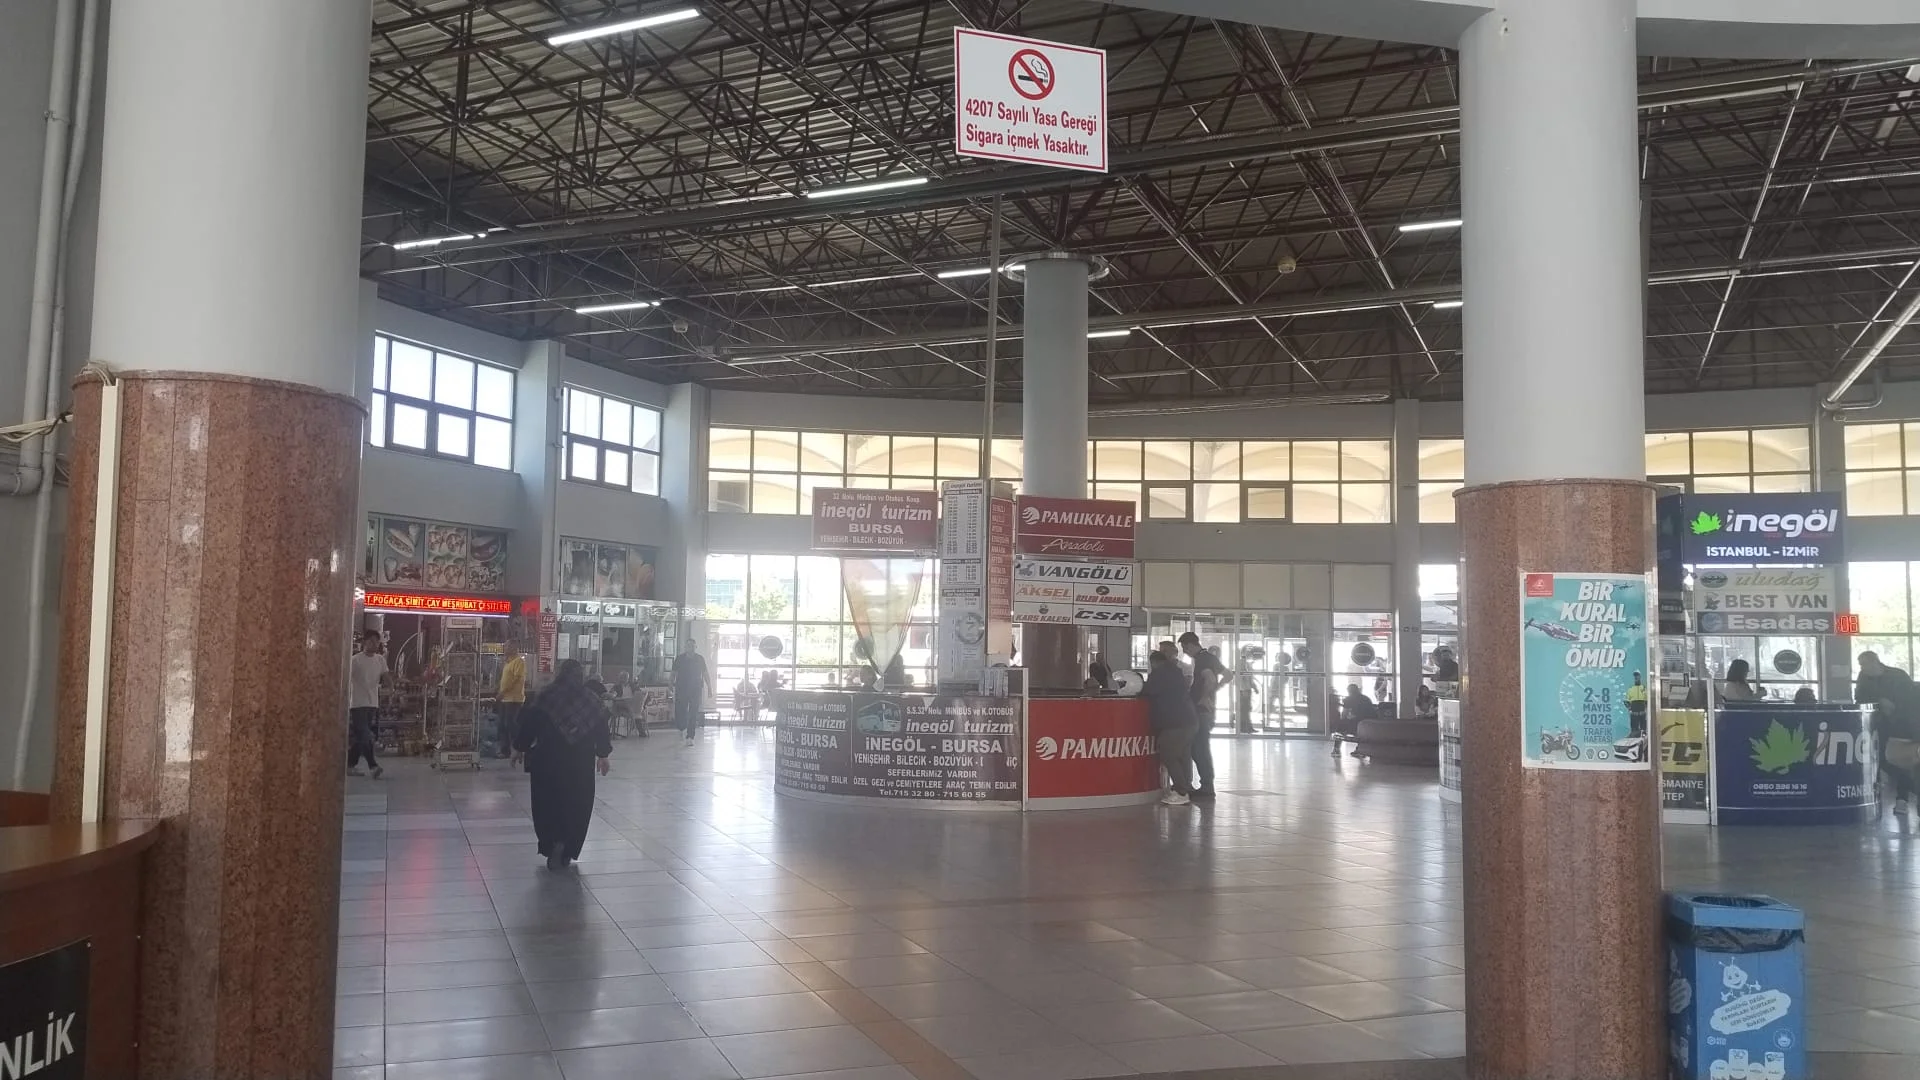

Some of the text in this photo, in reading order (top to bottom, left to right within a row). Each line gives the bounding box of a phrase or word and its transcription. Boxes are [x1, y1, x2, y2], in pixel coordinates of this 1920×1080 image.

[966, 98, 1097, 136] 4207 Sayılı Yasa Gereği
[966, 123, 1089, 156] Sigara içmek Yasaktır.
[881, 504, 932, 521] turizm
[1041, 510, 1133, 528] PAMUKKALE
[848, 523, 904, 534] BURSA
[1726, 509, 1838, 538] inegöl
[1041, 538, 1105, 552] Anadolu
[1039, 565, 1129, 581] VANGÖLÜ
[1735, 570, 1825, 591] uludağ
[1016, 586, 1073, 598] AKSEL
[1725, 595, 1828, 608] BEST VAN
[1075, 610, 1130, 621] CSR
[1560, 602, 1627, 623] KURAL
[1565, 645, 1626, 668] ÖMÜR
[1583, 687, 1610, 703] 2-8
[973, 708, 980, 716] ve
[1583, 703, 1612, 712] MAYIS
[812, 716, 846, 729] turizm
[964, 719, 1014, 733] turizm
[1583, 714, 1612, 726] 2026
[801, 733, 838, 749] BURSA
[942, 738, 1003, 753] BURSA
[1583, 735, 1613, 744] HAFTASI
[1060, 736, 1158, 760] PAMUKKAL
[947, 770, 977, 778] VARDIR
[853, 776, 869, 786] ÖZEL
[945, 781, 966, 790] ARAÇ
